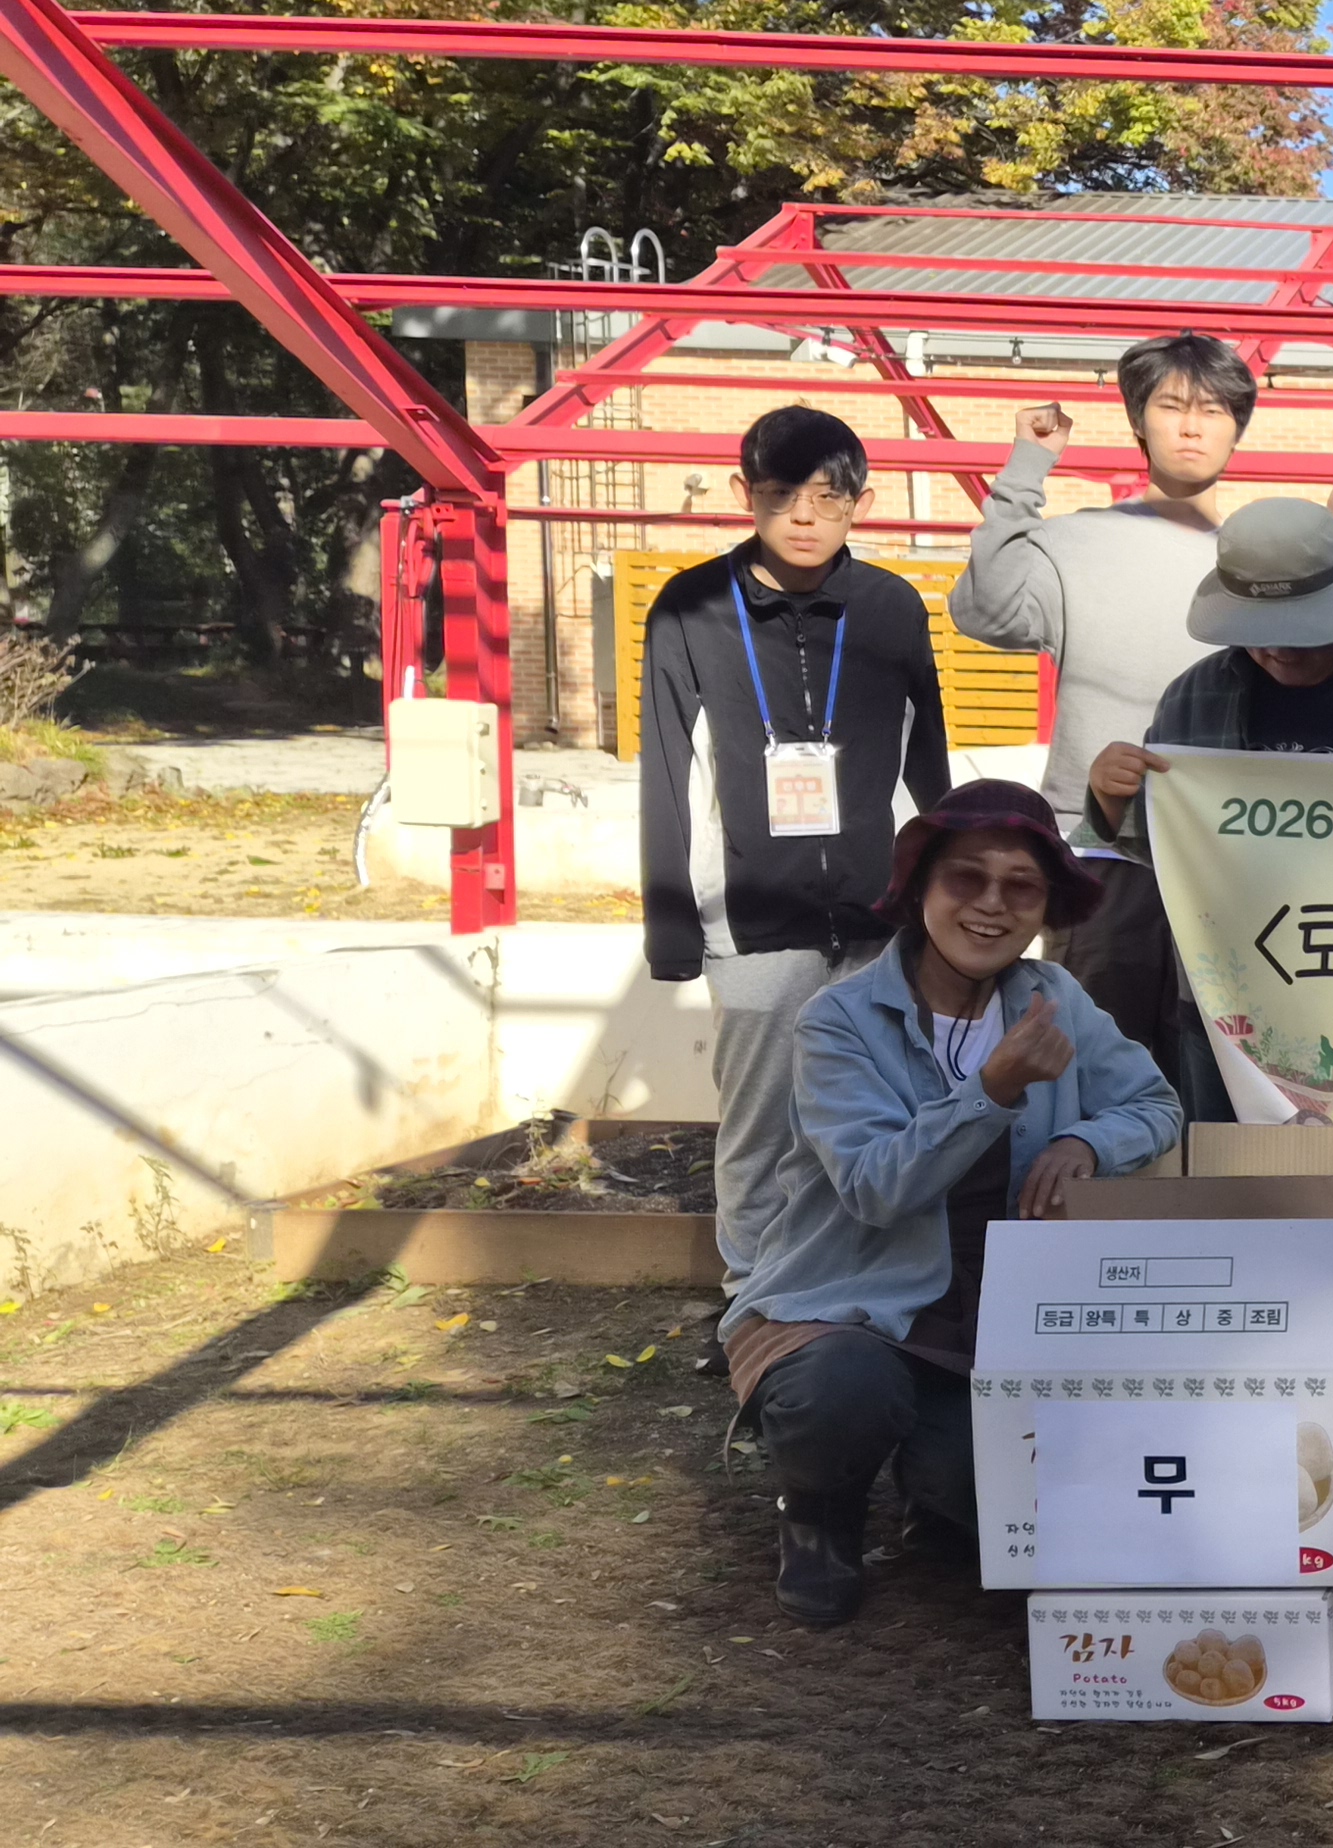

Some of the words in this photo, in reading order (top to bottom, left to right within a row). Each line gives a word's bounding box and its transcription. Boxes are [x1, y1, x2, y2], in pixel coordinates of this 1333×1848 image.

[1106, 1266, 1141, 1281] 생산자
[1042, 1310, 1075, 1328] 등급
[1086, 1310, 1116, 1327] 왕특
[1134, 1310, 1150, 1327] 특
[1175, 1309, 1192, 1327] 상
[1216, 1309, 1233, 1326] 중
[1250, 1308, 1281, 1326] 조림
[1137, 1455, 1195, 1515] 무
[1060, 1632, 1135, 1663] 감자
[1072, 1673, 1128, 1685] Potato
[1273, 1697, 1297, 1709] 5kg
